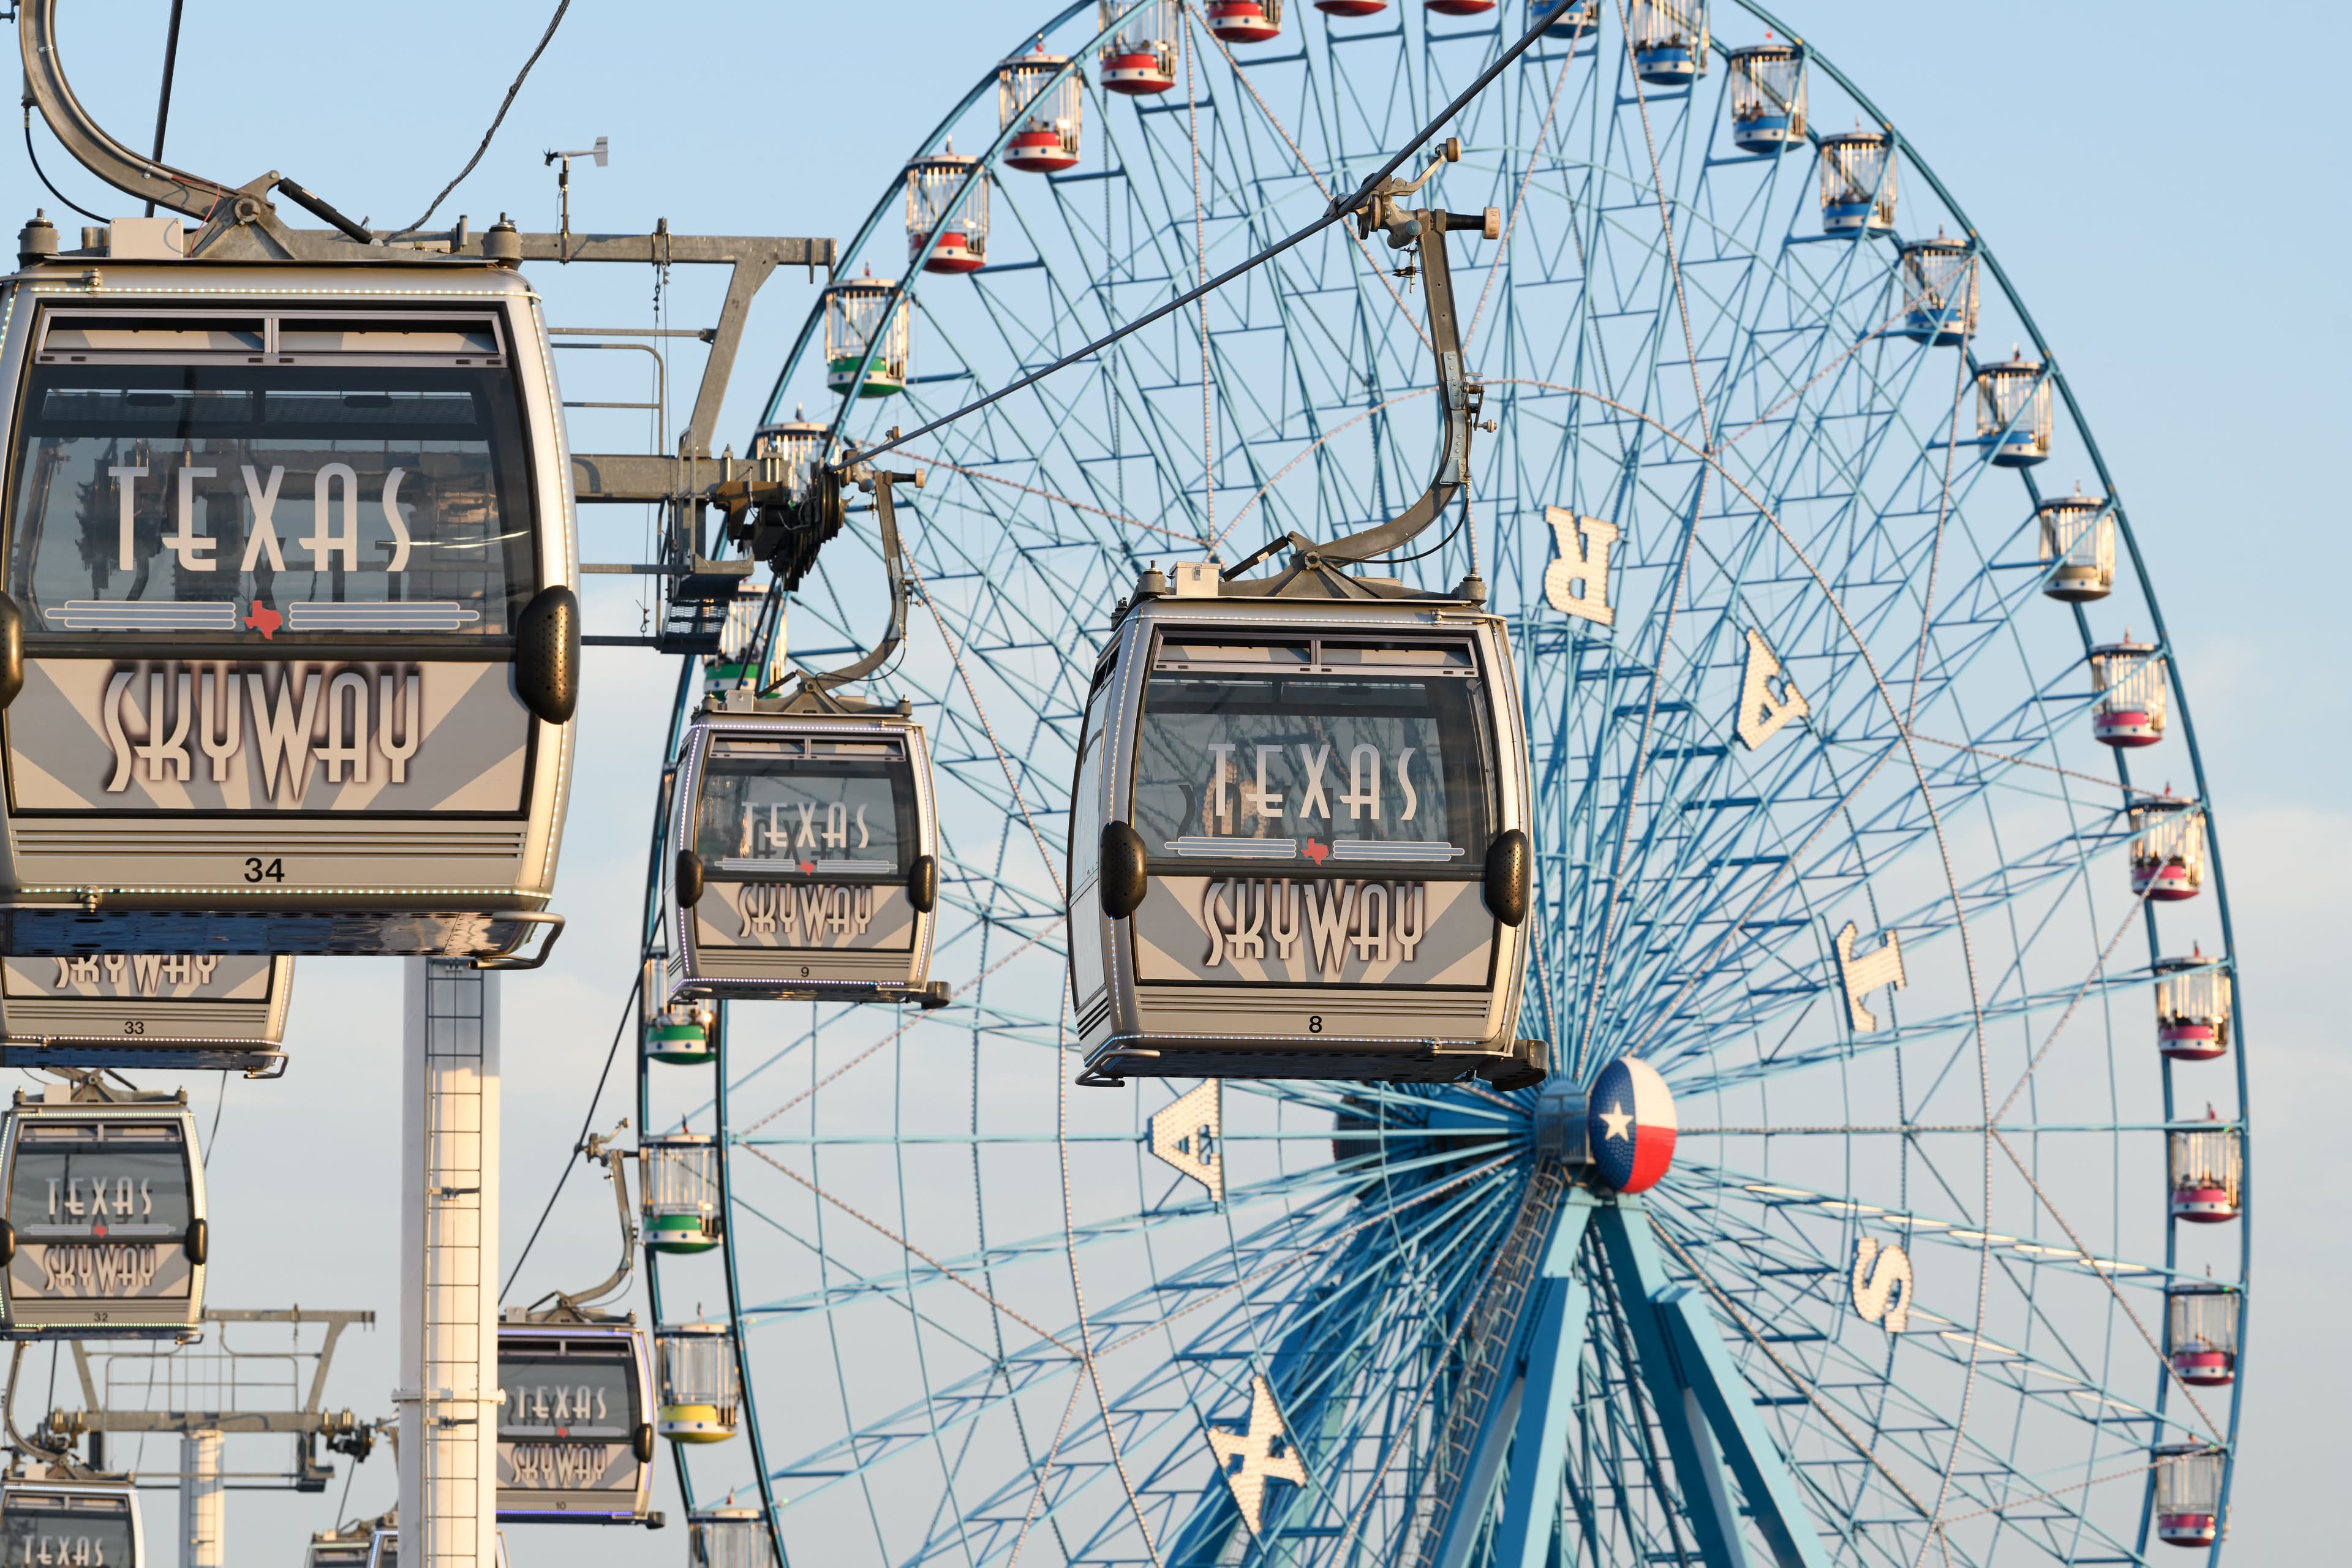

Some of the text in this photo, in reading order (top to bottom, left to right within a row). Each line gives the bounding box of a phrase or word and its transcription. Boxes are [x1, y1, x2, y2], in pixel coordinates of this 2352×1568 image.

[108, 462, 410, 571] TEXAS
[107, 669, 420, 801] SKYWAY
[1208, 743, 1417, 821] TEXAS
[742, 801, 869, 848] TEXAS
[243, 859, 285, 883] 34
[739, 886, 873, 941] SKYWAY
[1204, 882, 1424, 973] SKYWAY
[801, 967, 810, 978] 9
[124, 1021, 145, 1035] 33
[1308, 1015, 1323, 1034] 8
[45, 1176, 153, 1215] TEXAS
[44, 1246, 155, 1293] SKYWAY
[94, 1313, 108, 1323] 32
[516, 1385, 606, 1419] TEXAS
[512, 1446, 606, 1486] SKYWAY
[556, 1501, 567, 1510] 10
[23, 1535, 104, 1567] TEXAS
